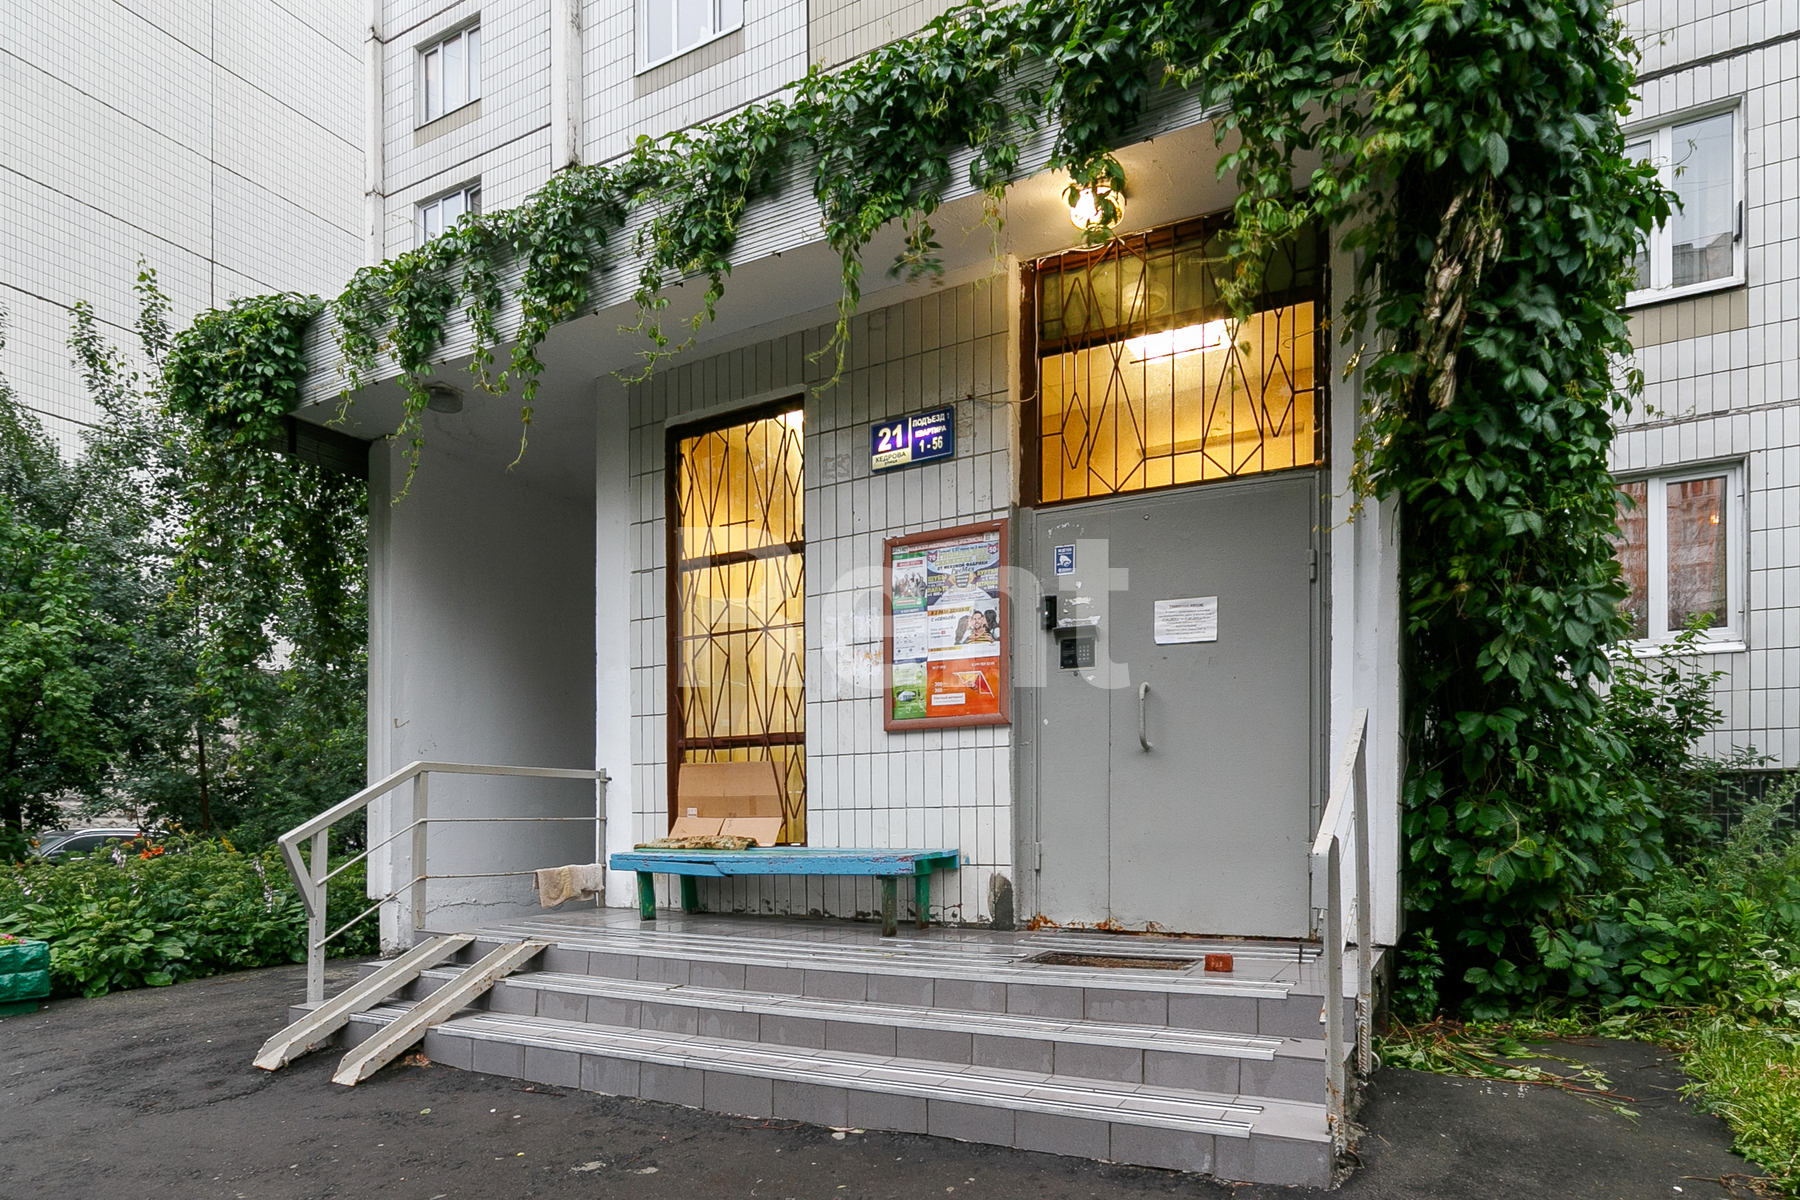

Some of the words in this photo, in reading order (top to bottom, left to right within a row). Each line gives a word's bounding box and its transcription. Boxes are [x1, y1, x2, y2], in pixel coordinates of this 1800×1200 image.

[912, 414, 946, 428] ПОДЪЕЗД
[878, 424, 903, 452] 21
[914, 425, 947, 438] КВАРТИРА
[875, 451, 906, 462] КЕДРОВА
